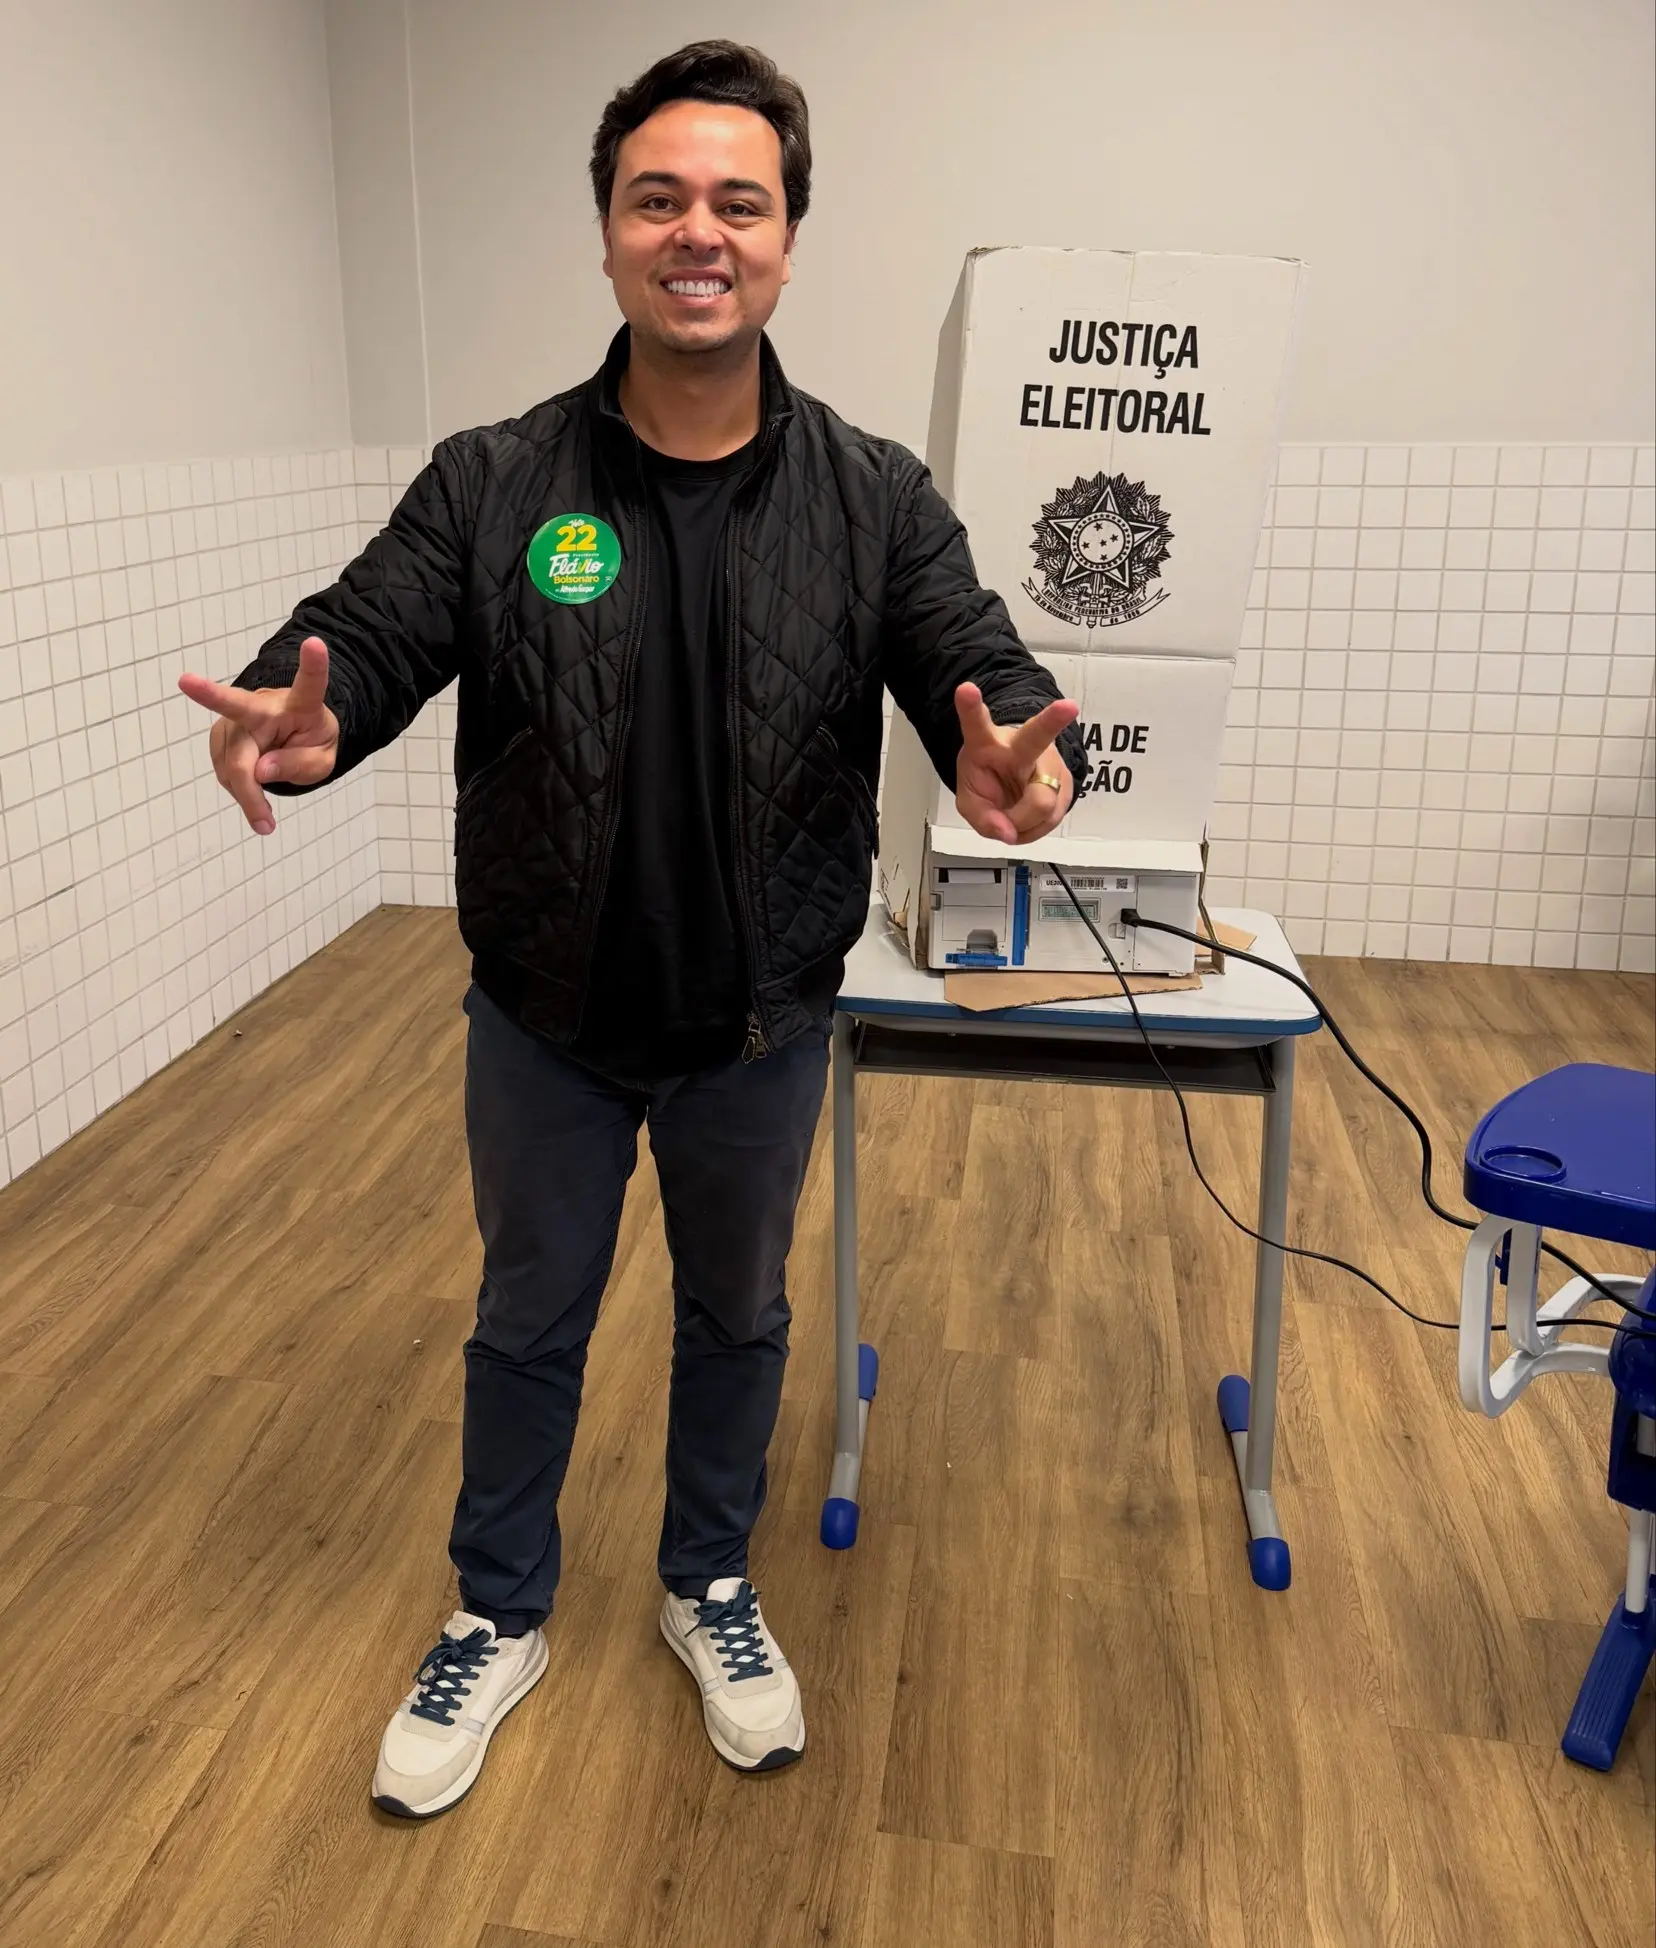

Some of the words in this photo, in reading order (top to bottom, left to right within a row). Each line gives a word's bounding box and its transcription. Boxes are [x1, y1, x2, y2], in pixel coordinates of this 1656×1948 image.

[1049, 320, 1198, 379] JUSTIÇA
[1020, 384, 1211, 435] ELEITORAL
[556, 525, 597, 552] 22
[549, 553, 604, 577] Flávio
[554, 576, 599, 584] Bolsonaro
[1110, 725, 1149, 753] DE
